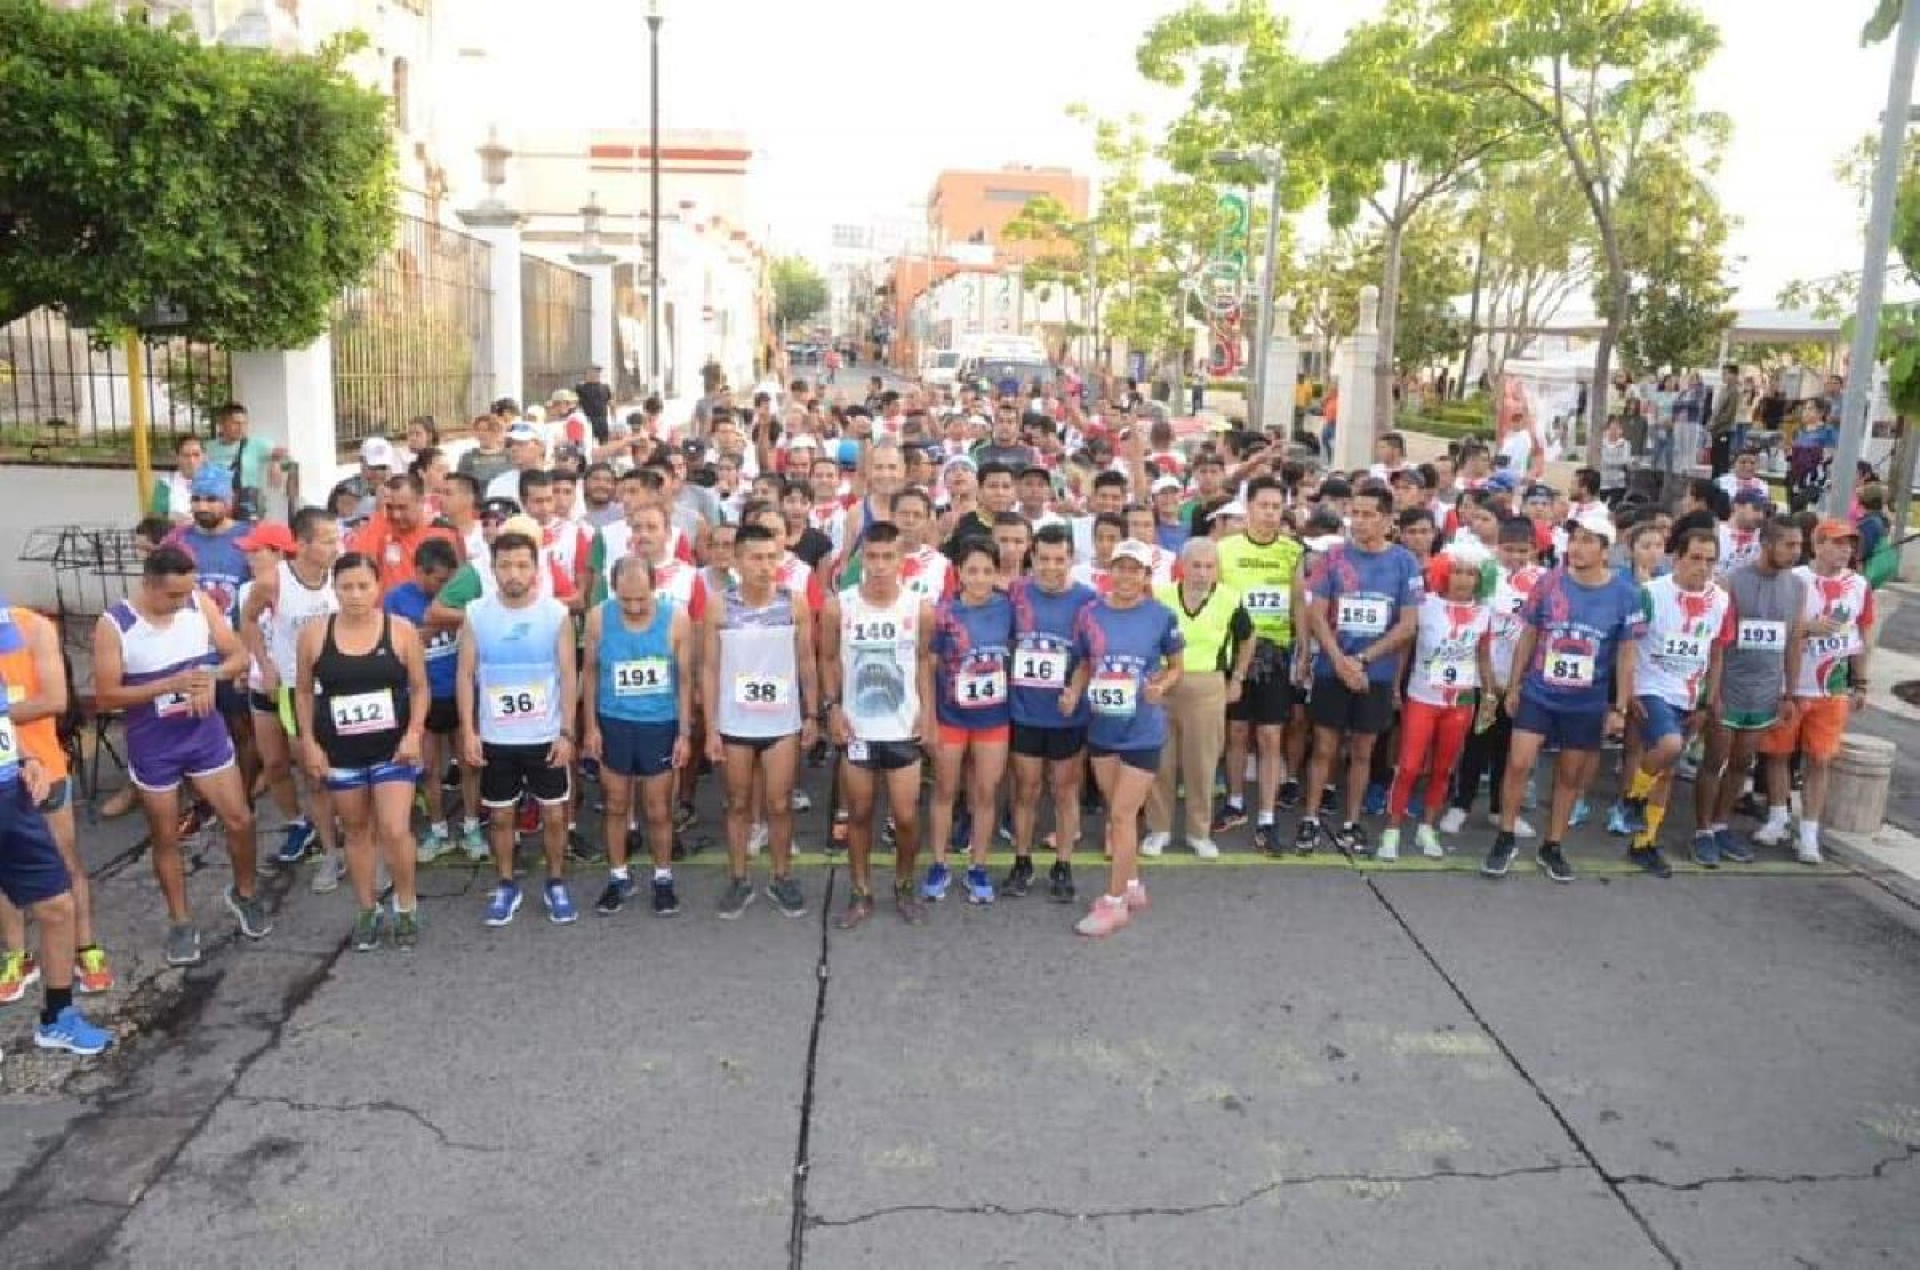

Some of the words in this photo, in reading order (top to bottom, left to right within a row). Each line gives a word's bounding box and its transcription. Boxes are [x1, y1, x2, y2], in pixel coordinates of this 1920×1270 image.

[618, 669, 659, 687] 191
[1553, 660, 1582, 679] 81
[745, 682, 776, 702] 38
[967, 681, 994, 701] 14
[501, 693, 533, 714] 36
[337, 703, 383, 726] 112
